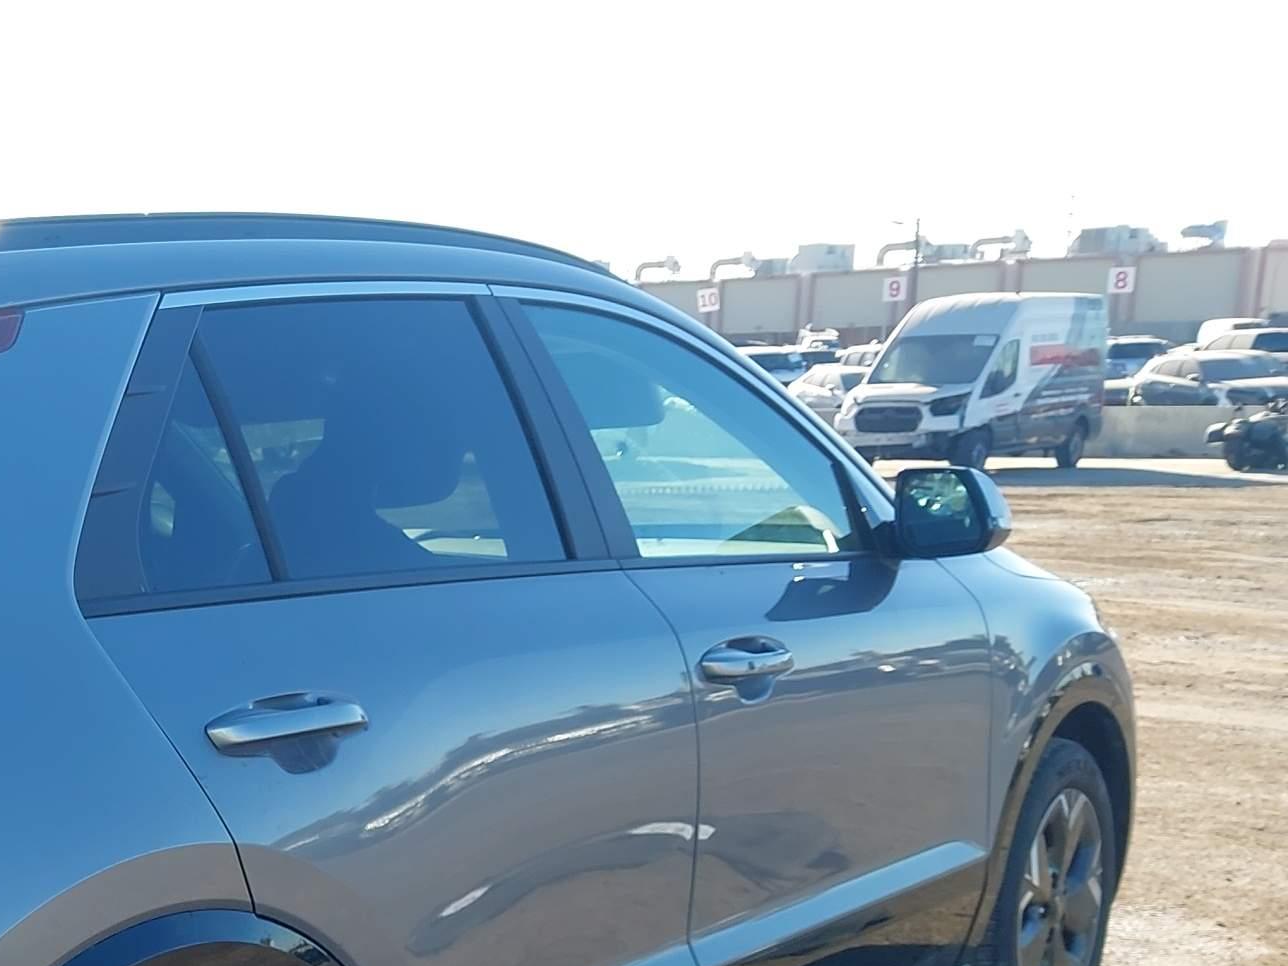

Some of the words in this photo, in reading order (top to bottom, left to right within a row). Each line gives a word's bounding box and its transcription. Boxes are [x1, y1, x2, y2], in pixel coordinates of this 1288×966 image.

[888, 280, 901, 298] 9
[1114, 271, 1128, 290] 8
[700, 292, 719, 308] 10
